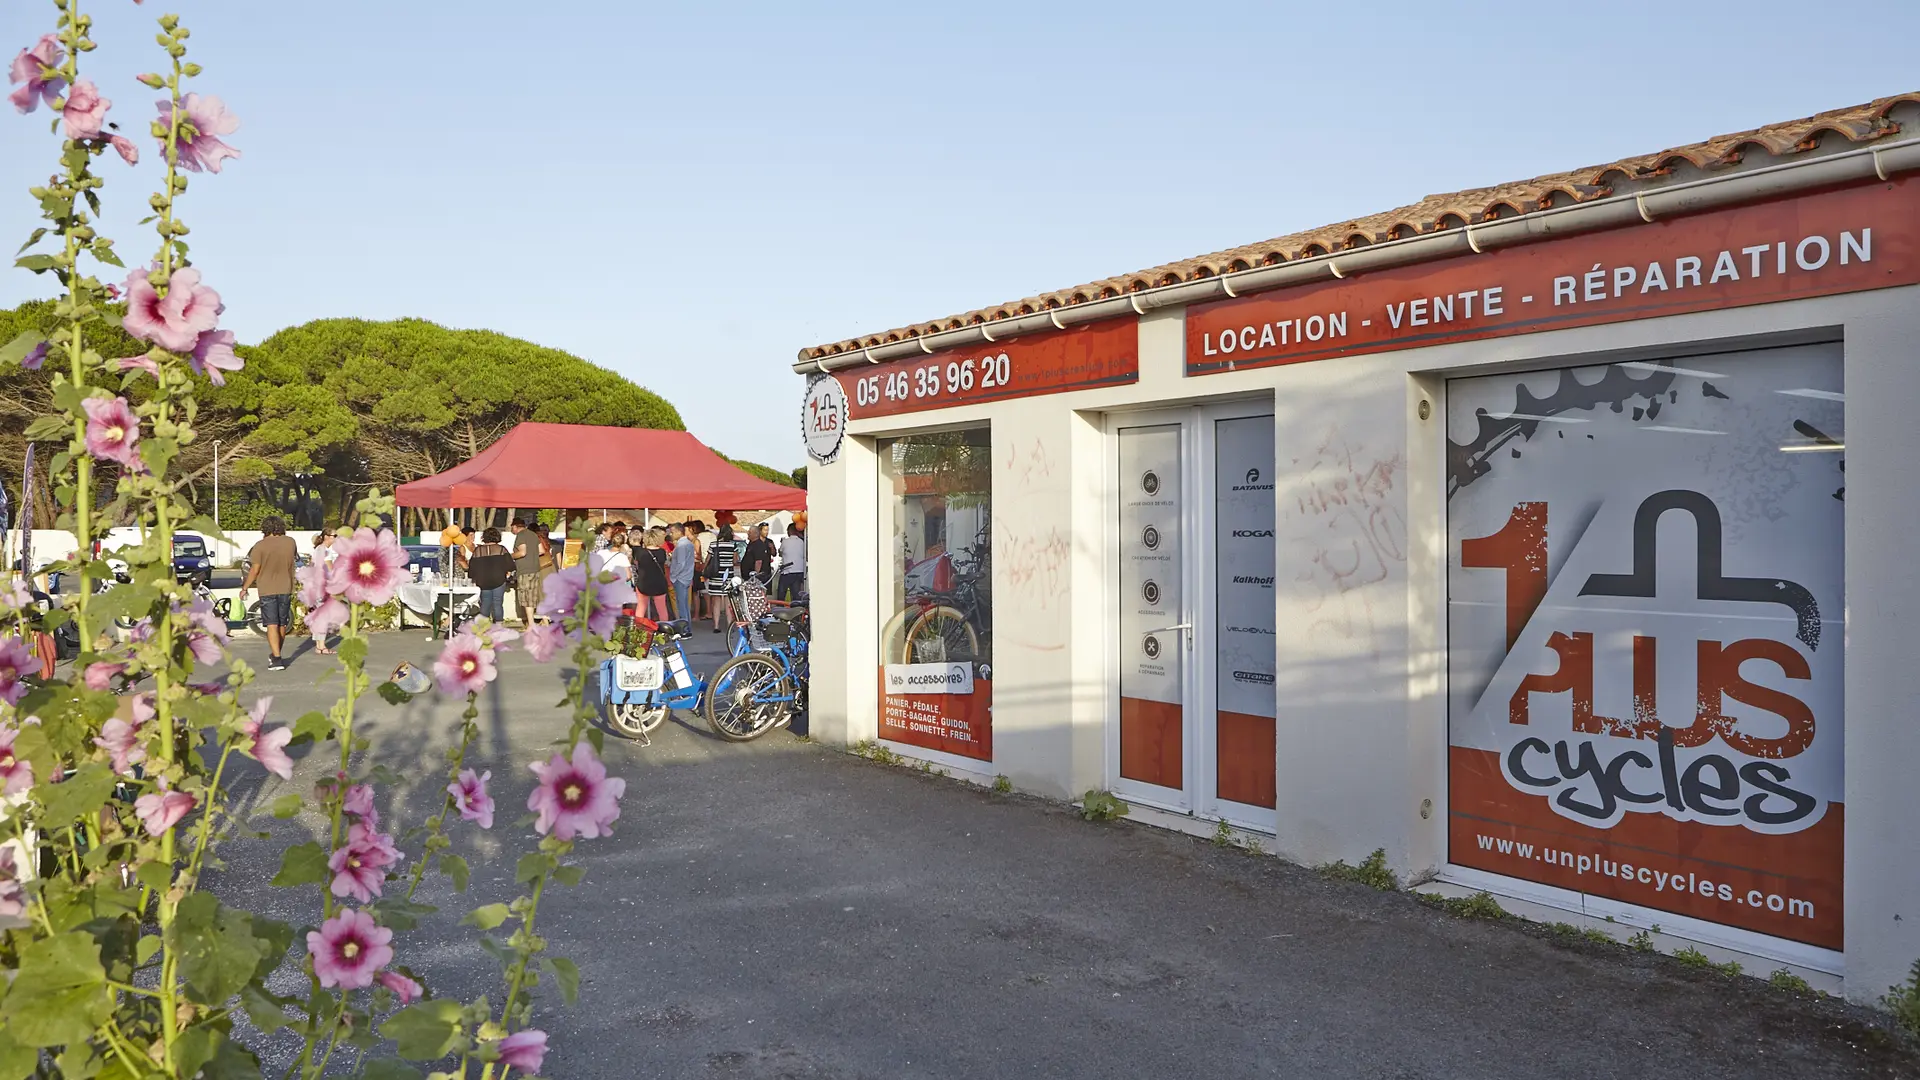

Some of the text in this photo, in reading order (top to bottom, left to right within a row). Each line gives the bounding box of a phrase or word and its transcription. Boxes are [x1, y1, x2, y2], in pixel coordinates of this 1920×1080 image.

[1204, 311, 1347, 356] LOCATION
[1386, 286, 1503, 329] VENTE
[1553, 228, 1871, 306] RÉPARATION
[857, 353, 1010, 407] 05 46 35 96 20
[1232, 530, 1274, 538] KOGA
[1233, 575, 1275, 584] Kalkhoff
[1461, 501, 1548, 656] 1
[890, 673, 963, 685] les accessoires
[1509, 630, 1816, 760] PLUS
[886, 696, 941, 715] PANIER, PÉDALE,
[886, 707, 971, 731] PORTE-BAGAGE, GUIDON,
[886, 717, 978, 743] SELLE, SONNETTE, FREIN...
[1507, 728, 1816, 825] cycles
[1476, 833, 1815, 919] www.unpluscycles.com
